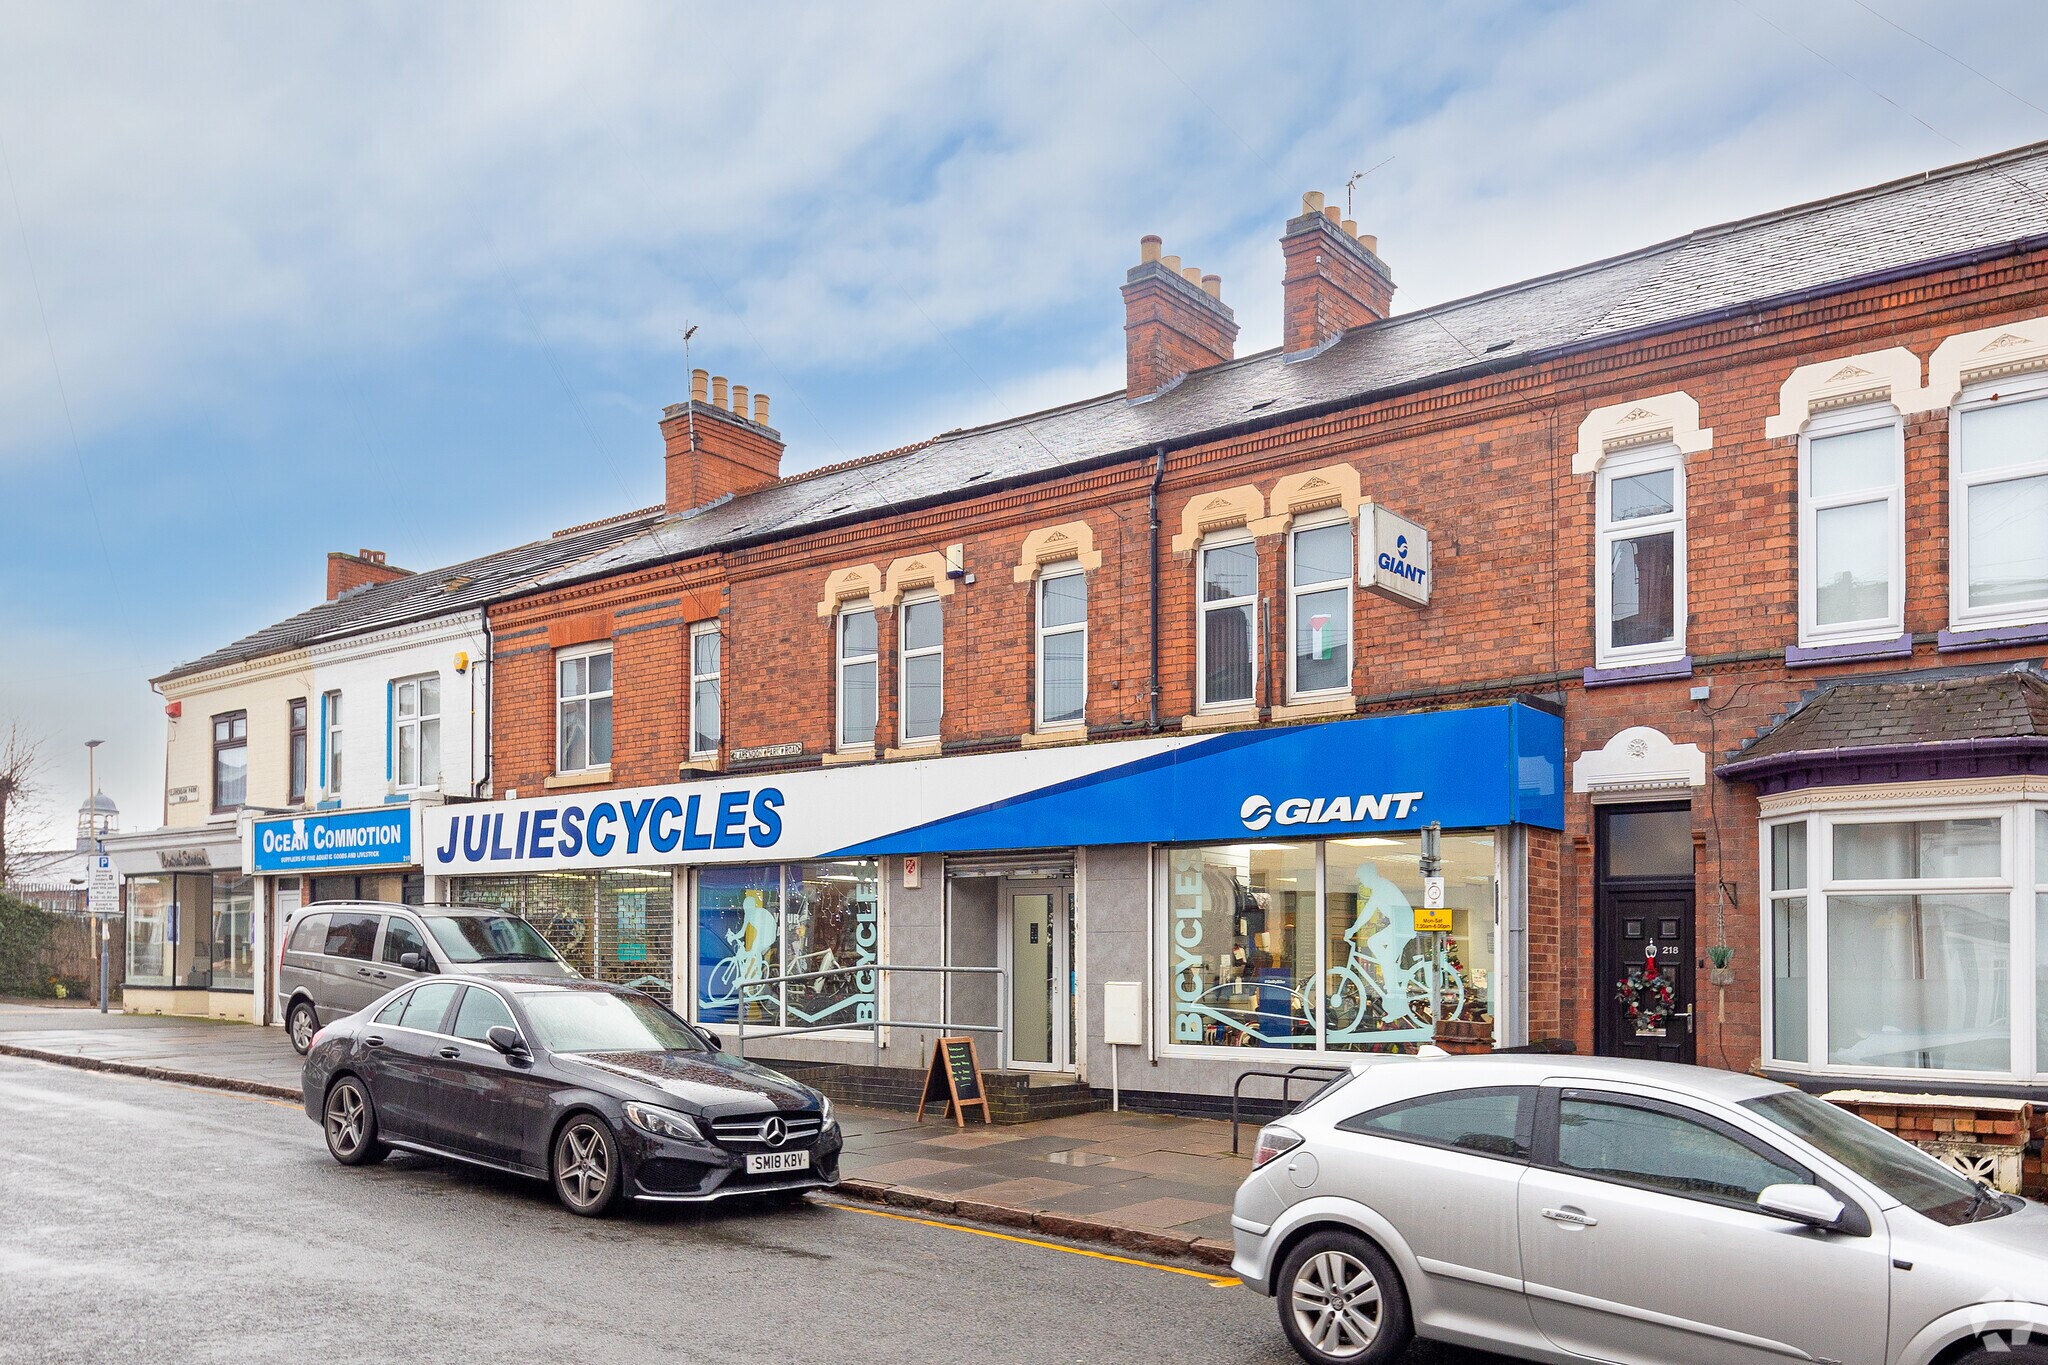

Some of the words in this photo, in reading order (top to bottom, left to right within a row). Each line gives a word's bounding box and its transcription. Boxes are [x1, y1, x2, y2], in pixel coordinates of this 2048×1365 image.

[1378, 552, 1426, 585] GIANT
[1275, 791, 1424, 825] GIANT
[263, 829, 308, 853] OCEAN
[313, 824, 401, 849] COMMOTION
[436, 788, 785, 864] JULIESCYCLES
[1175, 850, 1203, 1041] BICYCLES
[1662, 946, 1679, 954] 218
[755, 1155, 782, 1169] SM18
[784, 1153, 803, 1167] KBV
